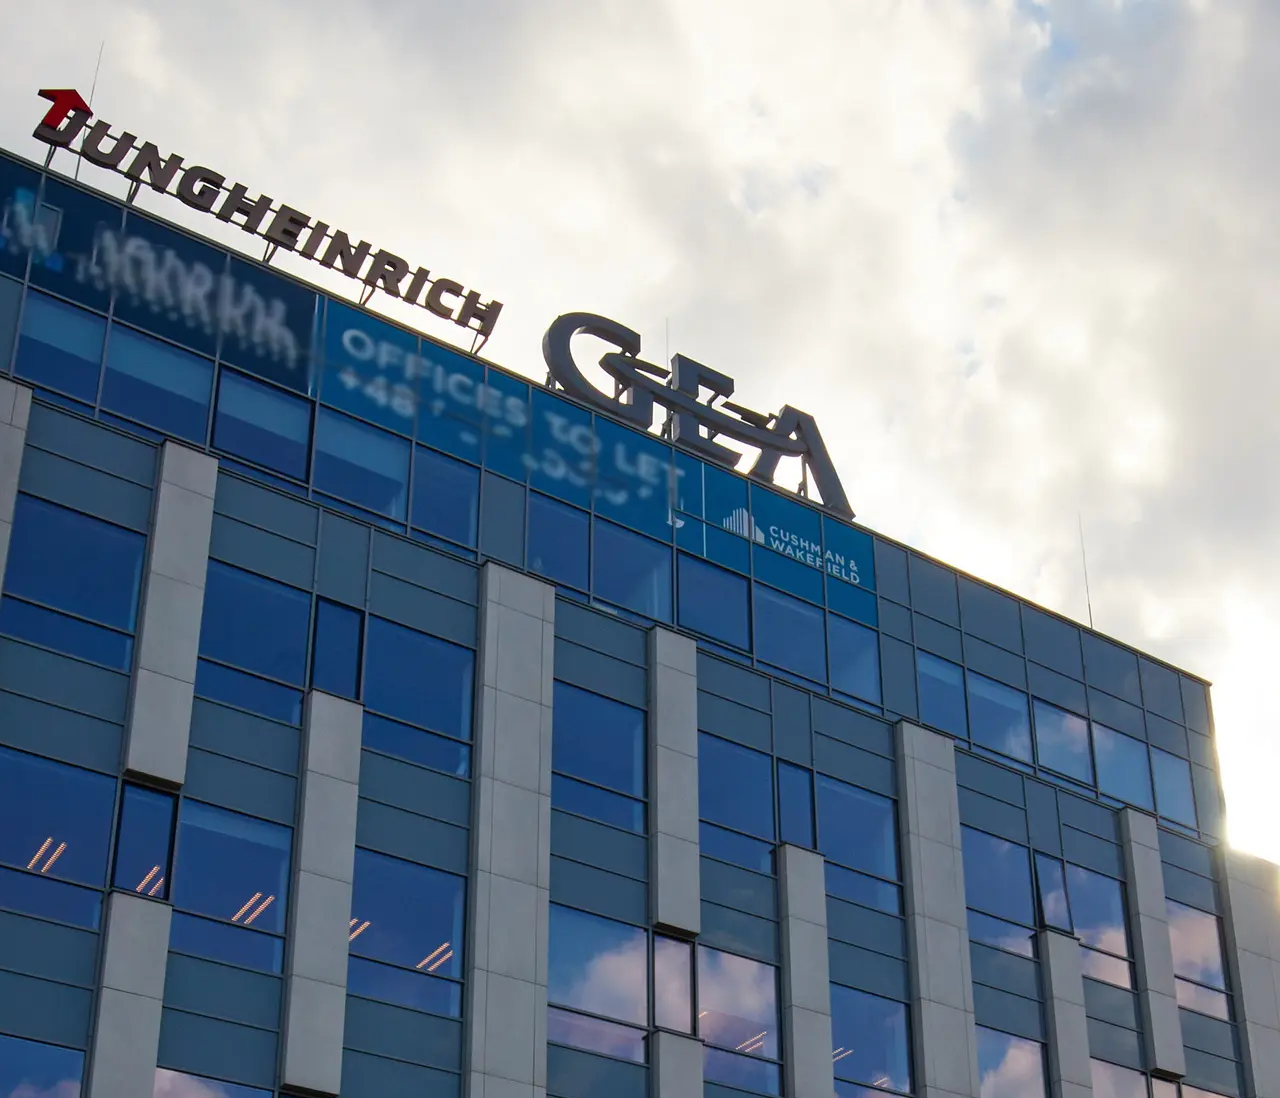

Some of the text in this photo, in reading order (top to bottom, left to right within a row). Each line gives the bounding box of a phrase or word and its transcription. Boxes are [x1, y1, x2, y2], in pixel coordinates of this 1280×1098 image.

[33, 89, 503, 337] JUNGHEINRICH
[341, 328, 529, 427] OFFICES
[542, 410, 602, 455] TO
[613, 443, 686, 493] LET
[542, 312, 856, 520] GEA
[770, 525, 858, 572] CUSHMAN &
[770, 537, 860, 584] WAKEFIELD
